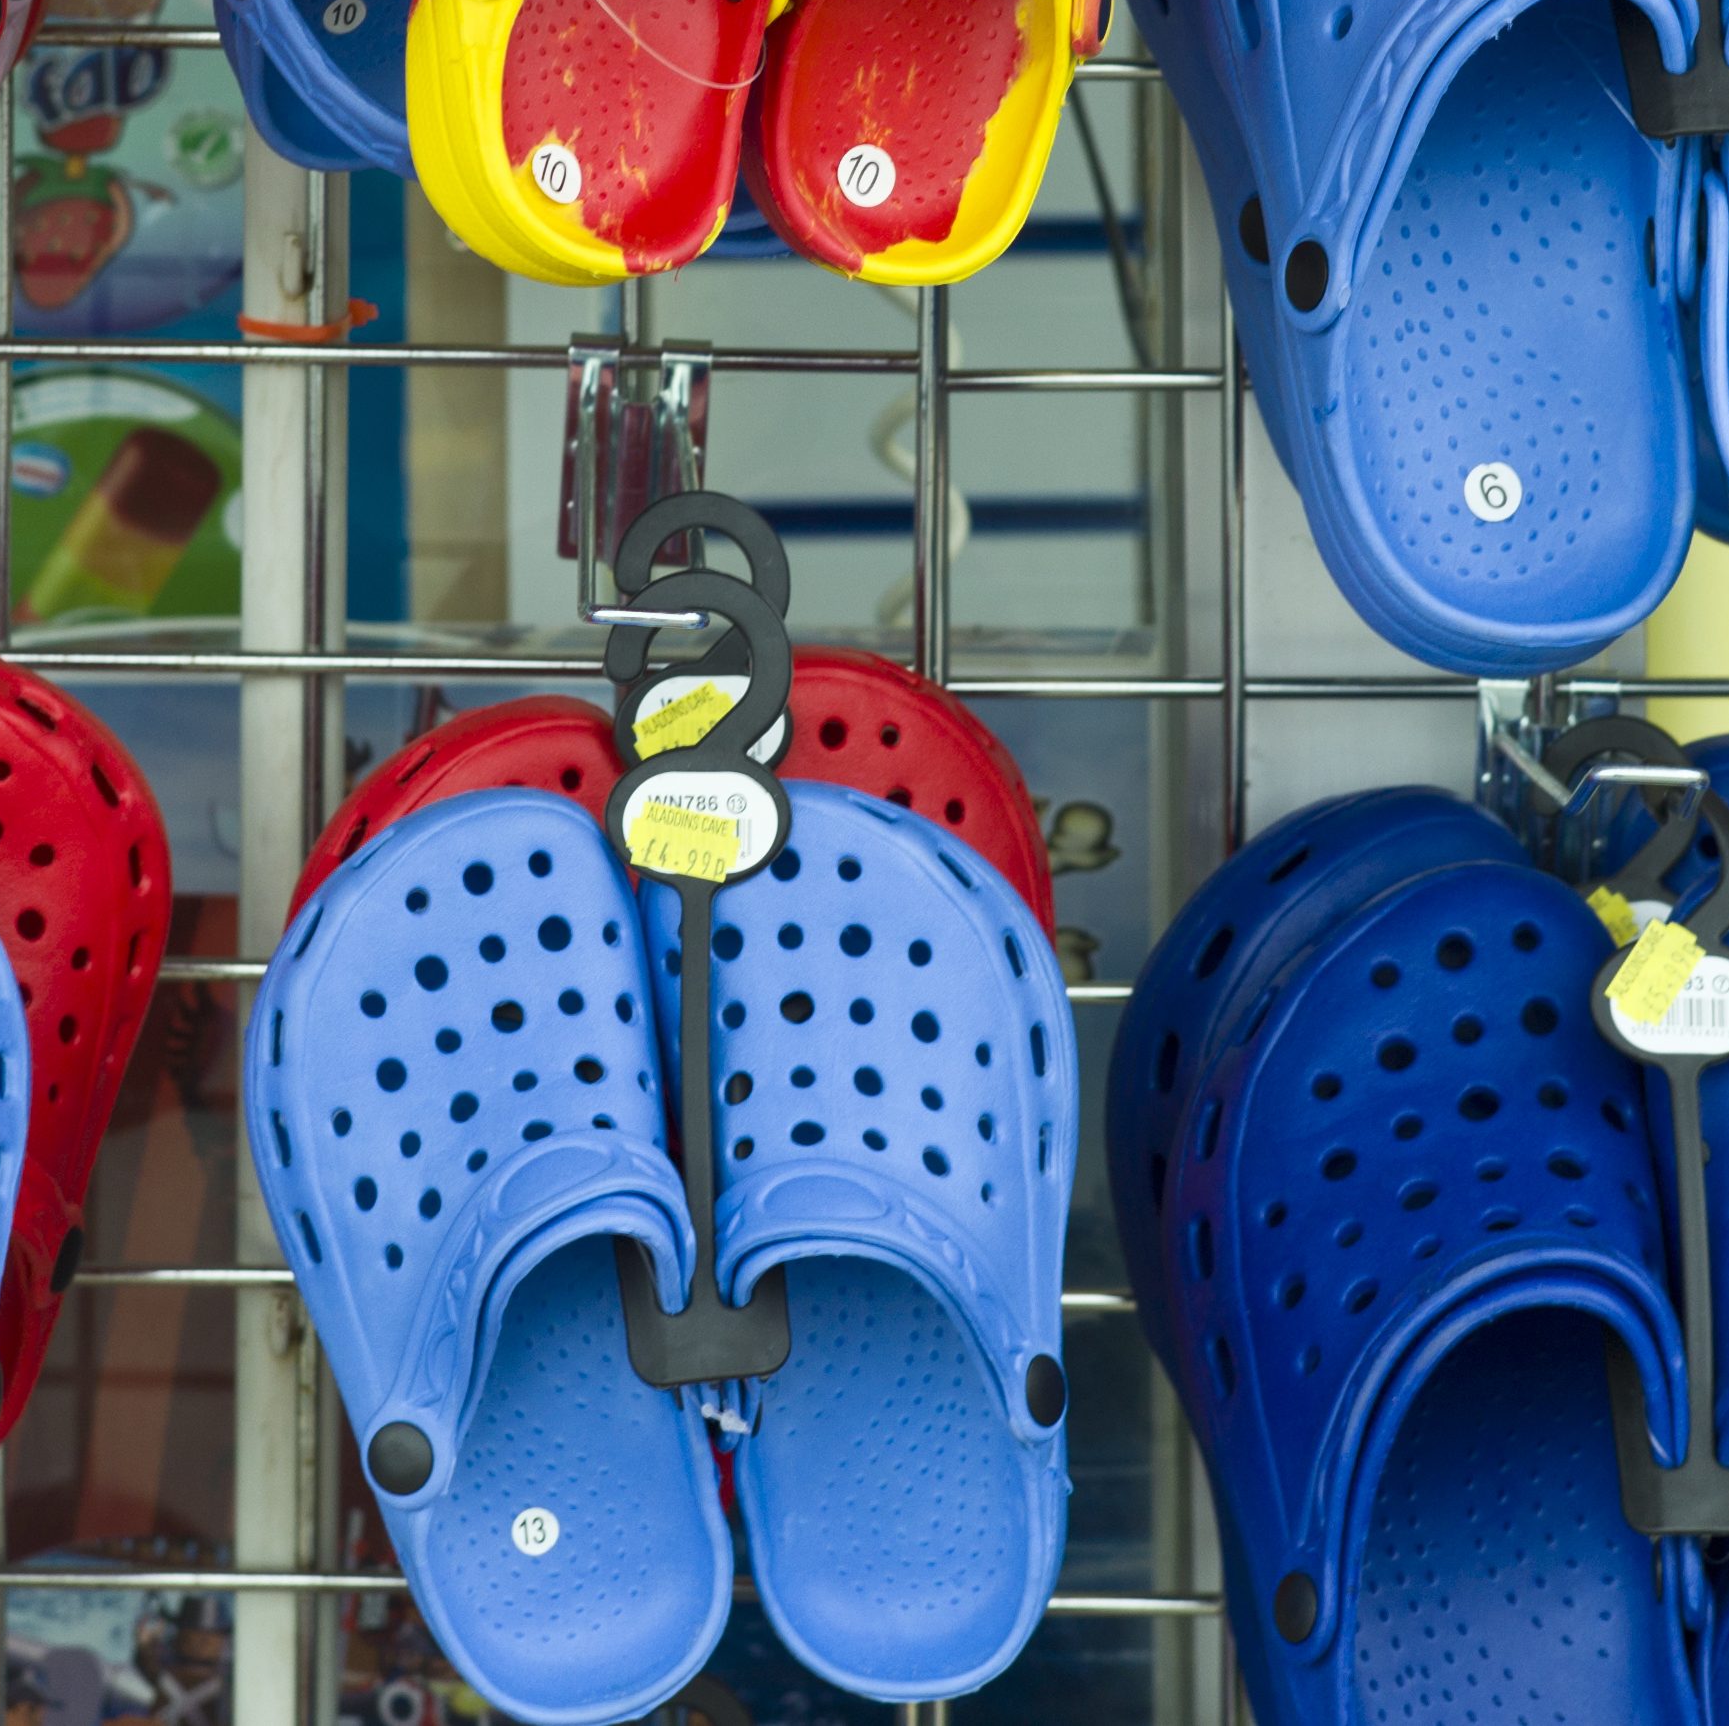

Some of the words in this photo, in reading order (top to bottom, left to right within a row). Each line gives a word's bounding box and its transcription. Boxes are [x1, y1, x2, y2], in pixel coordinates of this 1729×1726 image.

[332, 3, 358, 26] 10
[539, 153, 566, 193] 10
[846, 153, 880, 195] 10
[1479, 473, 1508, 509] 6
[642, 701, 686, 737] ALADDINS
[685, 685, 714, 711] CAVE
[647, 795, 718, 811] WN786
[647, 807, 699, 832] ALADDINS
[701, 818, 729, 836] CAVE
[644, 838, 725, 881] £4.99p
[518, 1516, 547, 1544] 13
